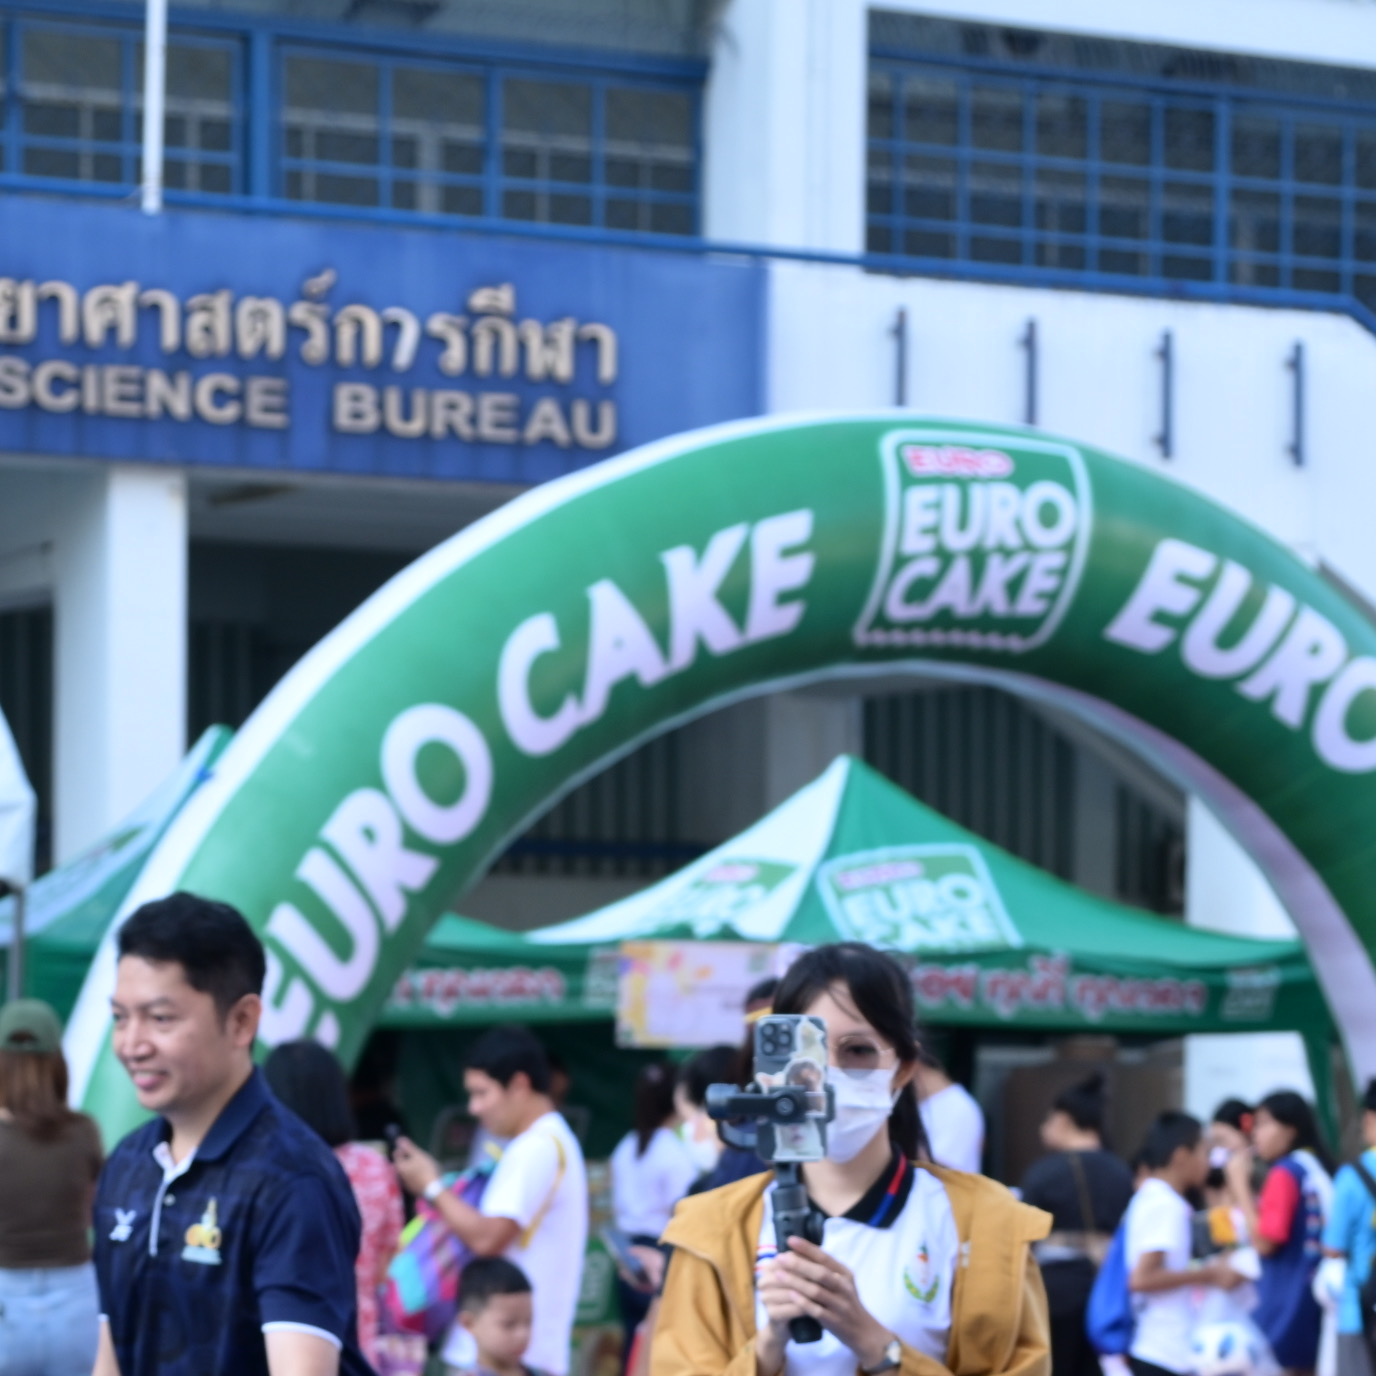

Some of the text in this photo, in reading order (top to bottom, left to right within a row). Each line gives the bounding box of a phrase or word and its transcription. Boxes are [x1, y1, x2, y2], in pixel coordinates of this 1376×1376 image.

[332, 381, 618, 451] BUREAU
[901, 480, 1078, 556] EURO
[884, 551, 1068, 622] CAKE
[258, 508, 816, 1051] EURO CAKE
